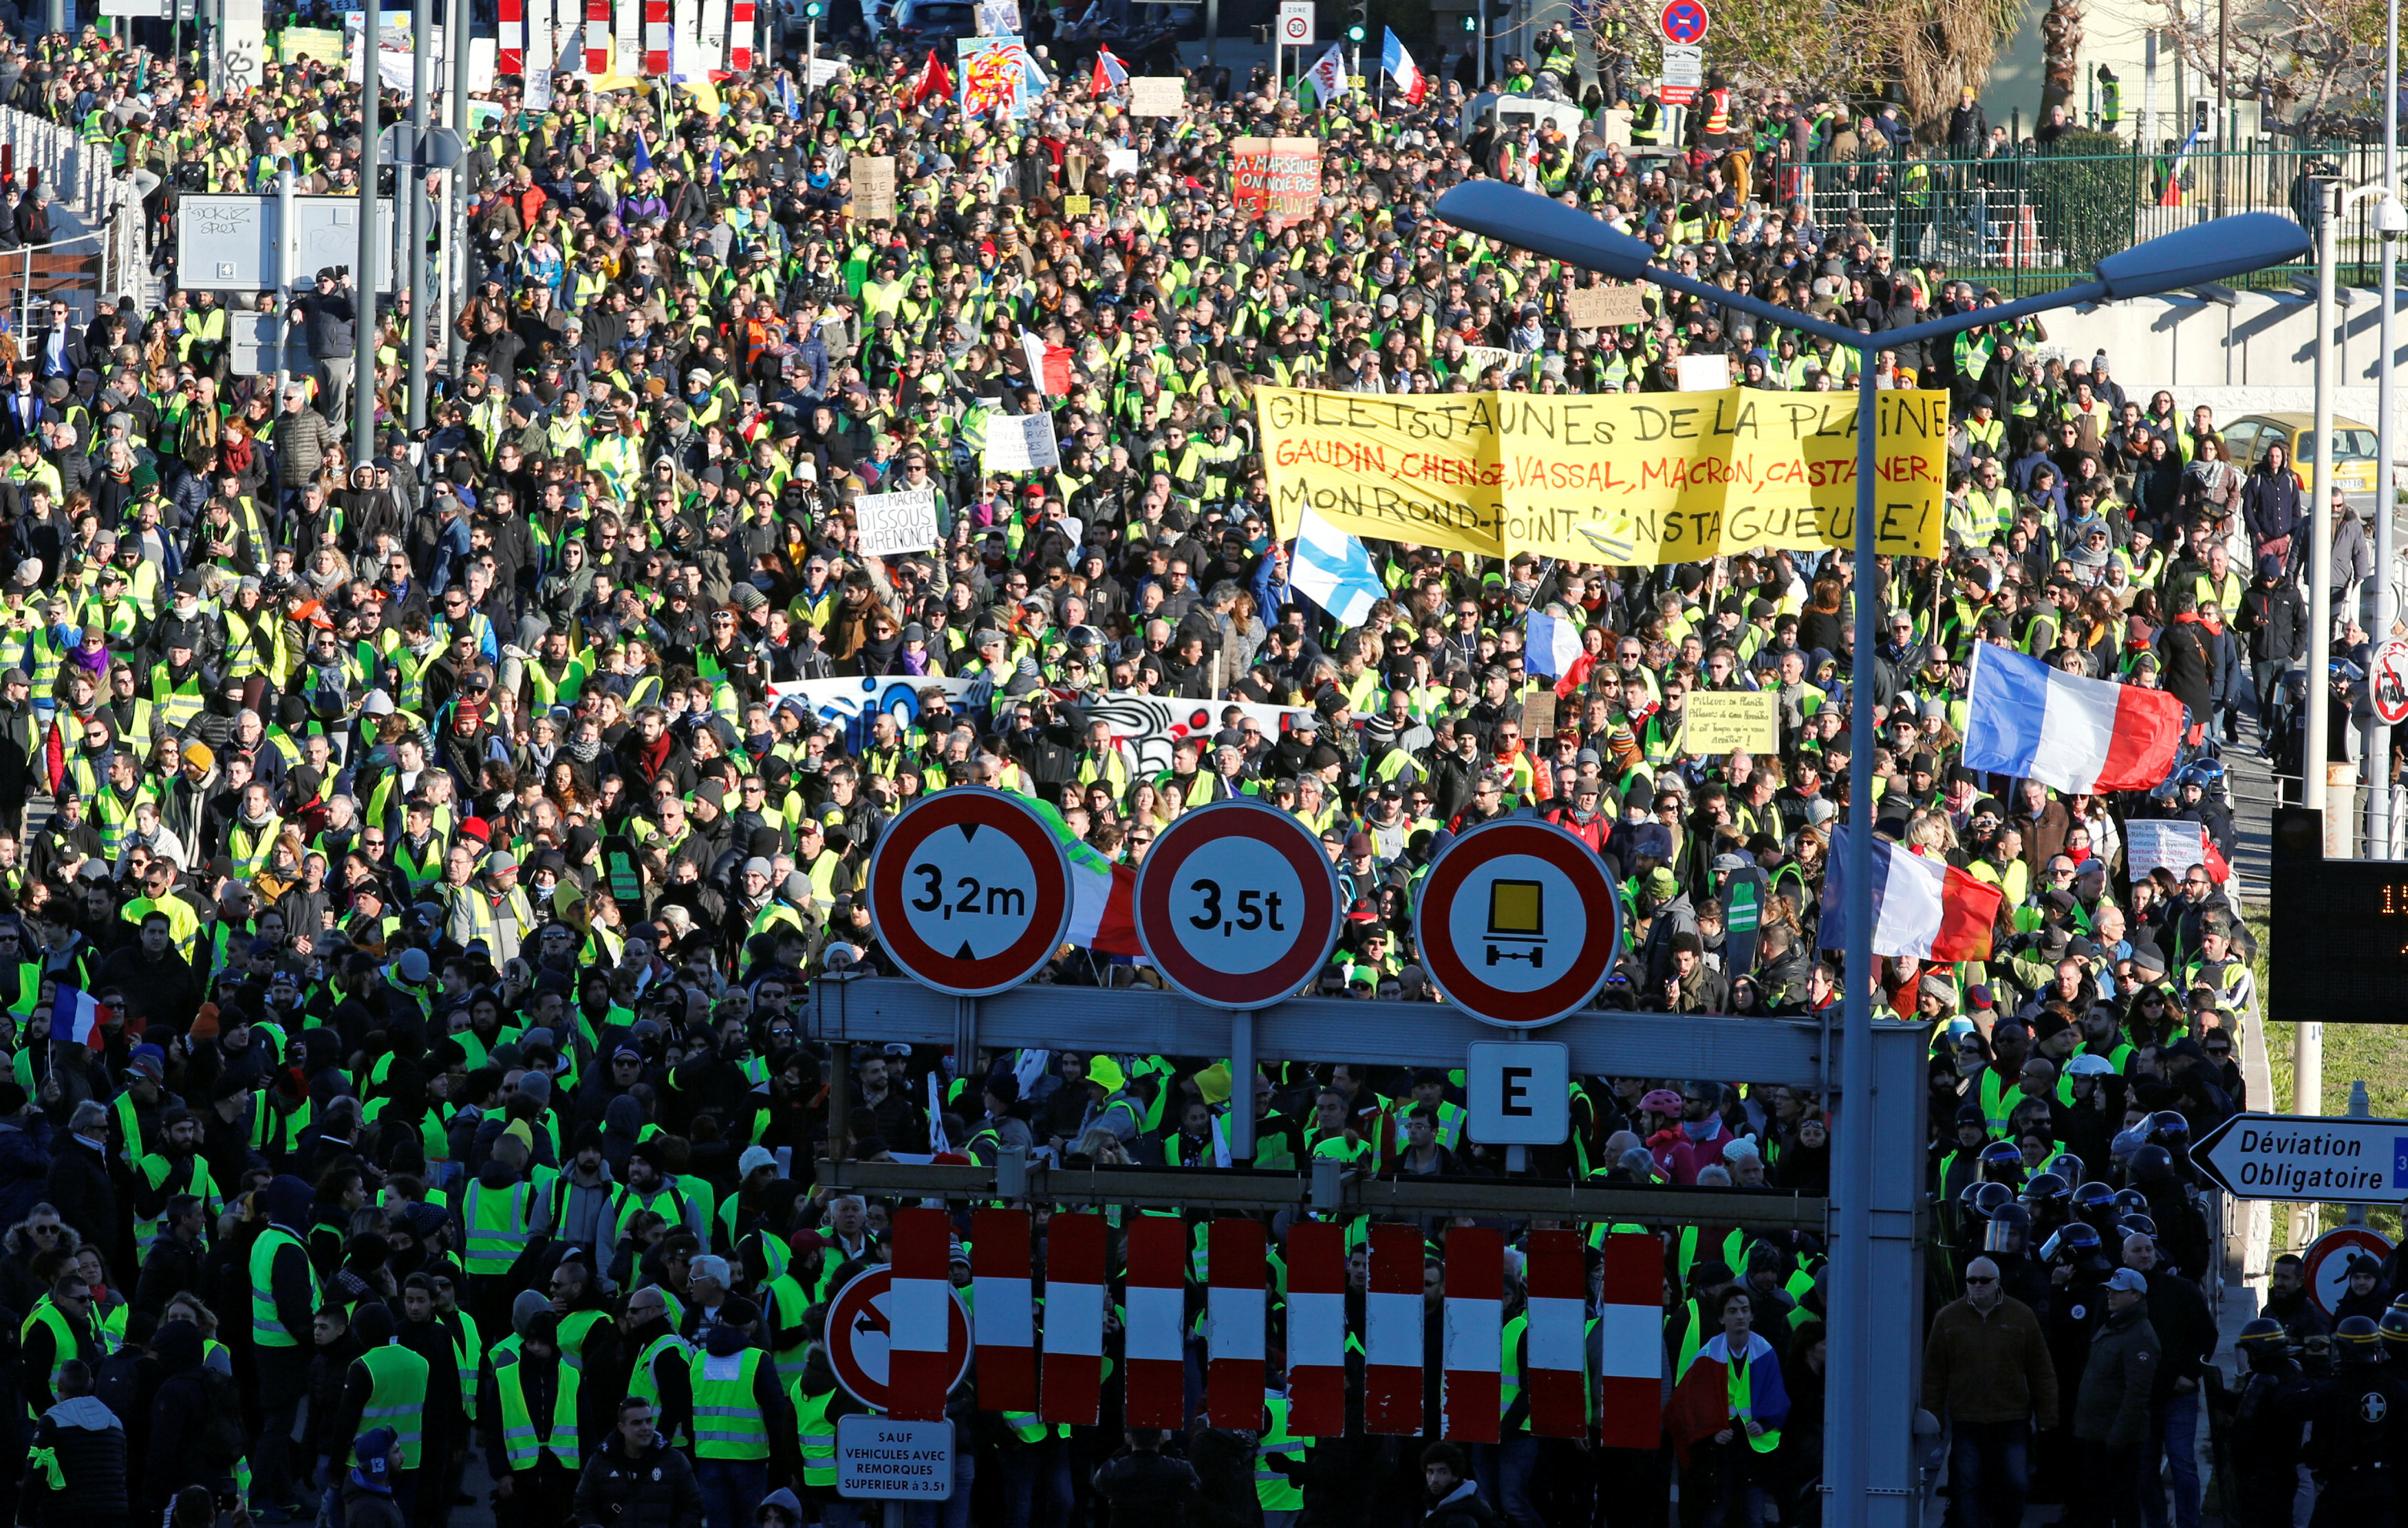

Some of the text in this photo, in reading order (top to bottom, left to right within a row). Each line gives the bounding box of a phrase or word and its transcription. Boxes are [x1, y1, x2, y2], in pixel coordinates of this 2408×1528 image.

[1291, 23, 1303, 32] 30
[1236, 155, 1320, 175] A MARSEILLE
[861, 181, 887, 192] TUE
[1240, 173, 1316, 193] ON NOIE PAS
[1262, 193, 1319, 215] JAUNE
[1572, 305, 1639, 319] LEUR MONDE
[1579, 300, 1591, 309] LA
[1630, 405, 1701, 442] DE
[1712, 398, 1759, 440] LA
[1280, 476, 1364, 524] MON
[859, 506, 931, 531] DISSOUS
[860, 525, 934, 551] OU RENONCE
[912, 863, 1025, 921] 3,2m
[1189, 878, 1285, 938] 3,5t
[1501, 1067, 1533, 1117] E
[2240, 1130, 2361, 1156] Déviation
[2240, 1161, 2383, 1193] Obligatoire
[879, 1432, 913, 1443] SAUF
[846, 1448, 945, 1461] VEHICULES AVEC
[371, 1457, 385, 1473] 13
[857, 1463, 933, 1476] REMORQUES
[845, 1478, 945, 1492] SUPERIEUR à 3.5t
